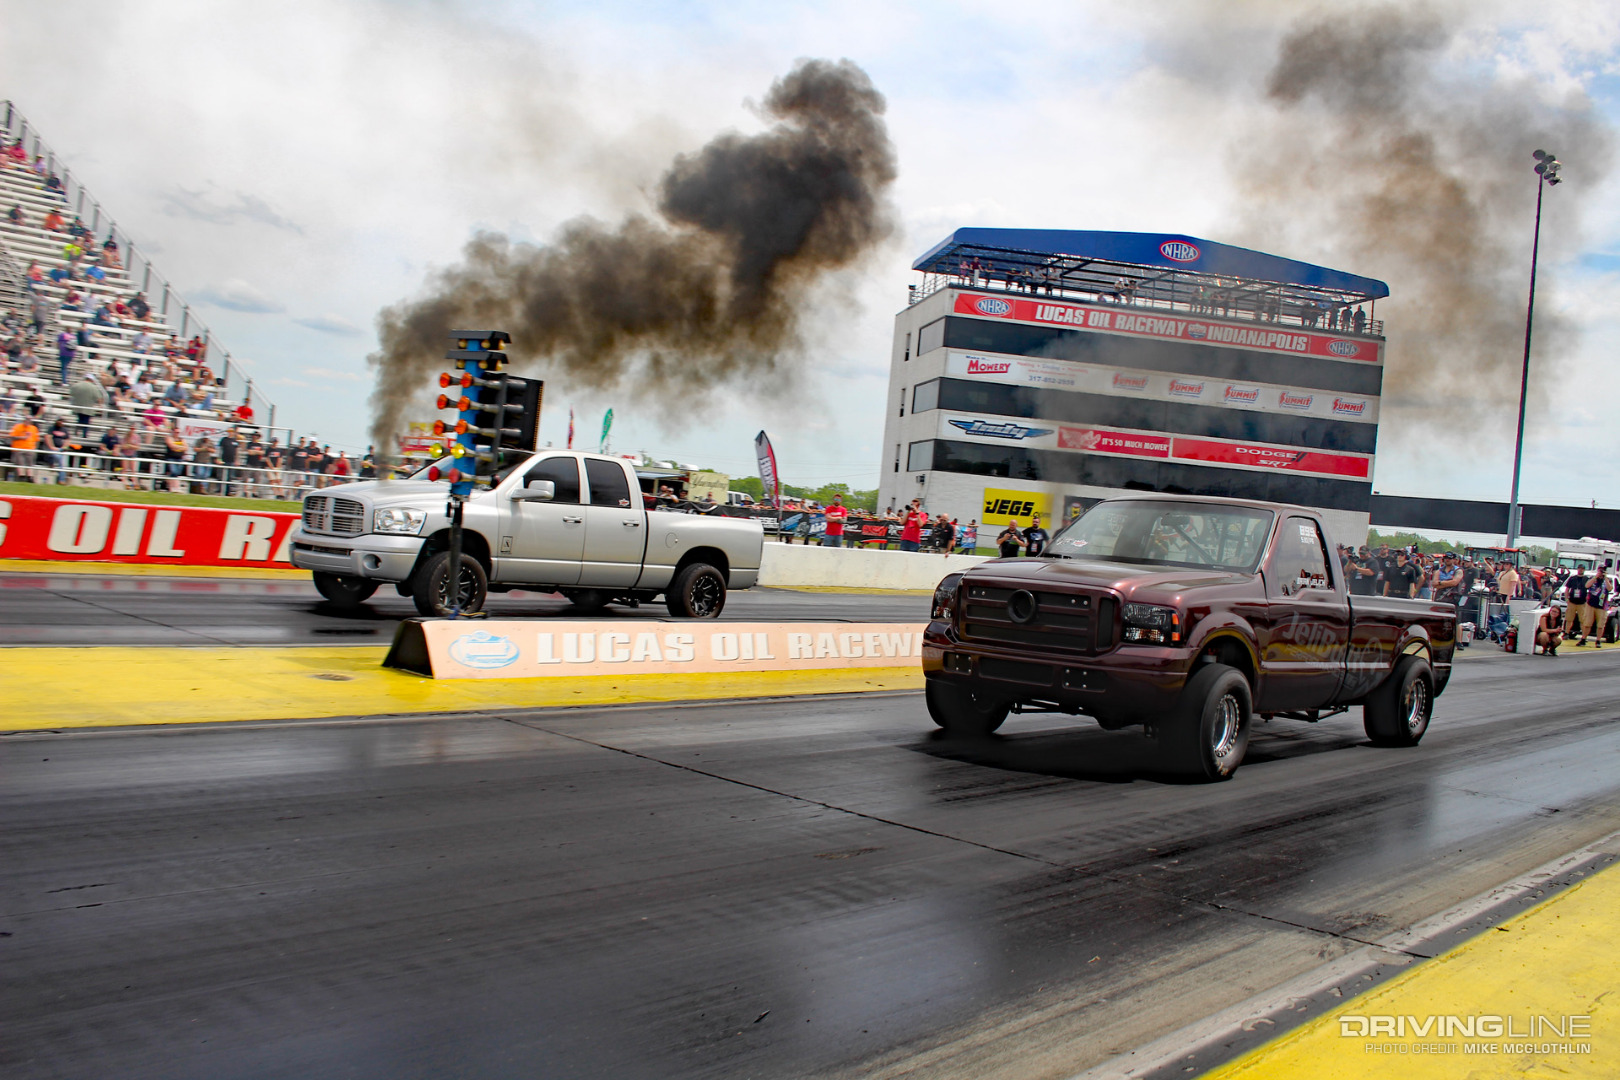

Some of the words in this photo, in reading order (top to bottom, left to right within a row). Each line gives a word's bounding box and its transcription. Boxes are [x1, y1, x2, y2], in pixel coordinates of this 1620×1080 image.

[1162, 243, 1199, 260] NHRA
[977, 298, 1011, 314] NHRA
[1035, 304, 1084, 325] LUCAS
[1088, 310, 1109, 327] OIL
[1115, 315, 1186, 337] RACEWAY
[1207, 325, 1308, 351] INDIANAPOLIS
[1329, 341, 1358, 356] NHRA
[1124, 440, 1143, 449] MUCH
[1235, 447, 1297, 459] DODGE
[1256, 459, 1292, 467] SRT
[47, 504, 185, 558] OIL
[537, 632, 695, 664] LUCAS
[710, 632, 776, 662] OIL
